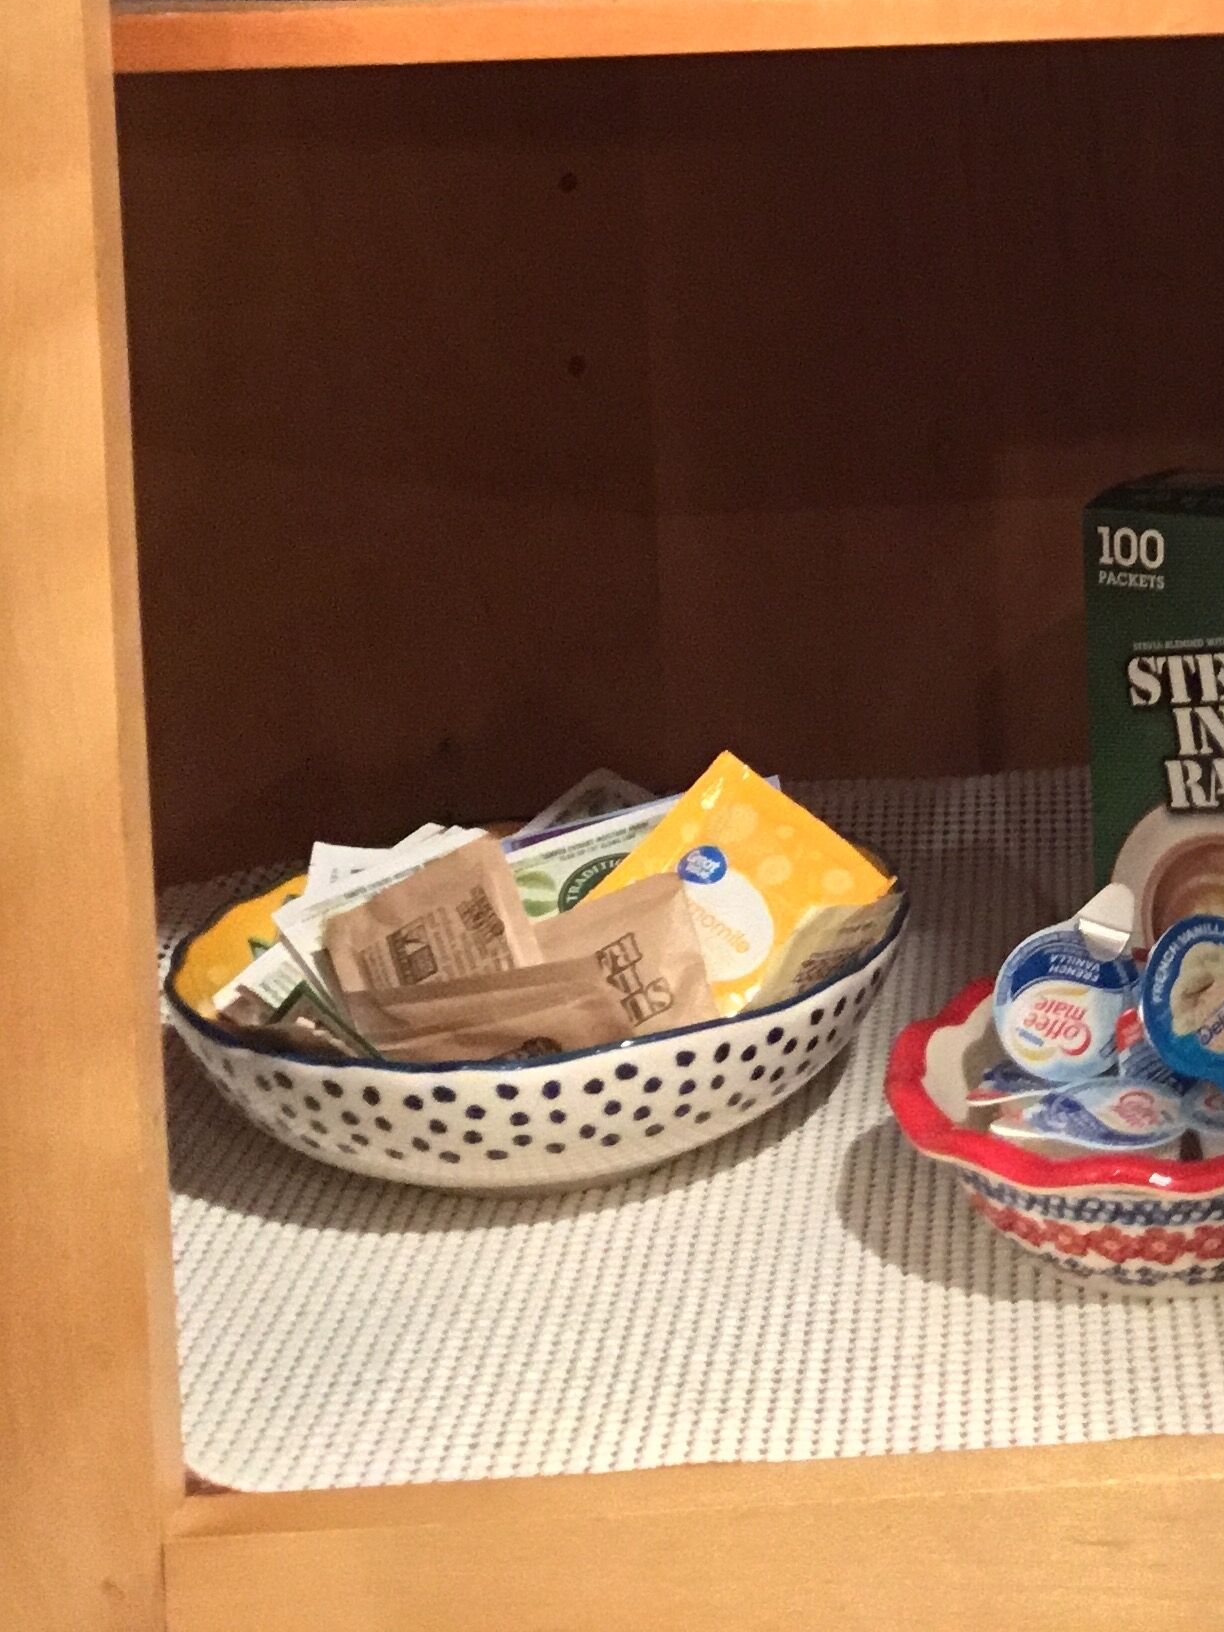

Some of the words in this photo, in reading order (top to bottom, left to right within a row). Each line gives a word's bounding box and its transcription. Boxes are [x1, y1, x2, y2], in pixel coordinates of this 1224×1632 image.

[1097, 526, 1165, 569] 100
[1098, 571, 1165, 590] PACKETS
[1050, 953, 1100, 971] VANILLA
[1049, 965, 1100, 982] FRENCH
